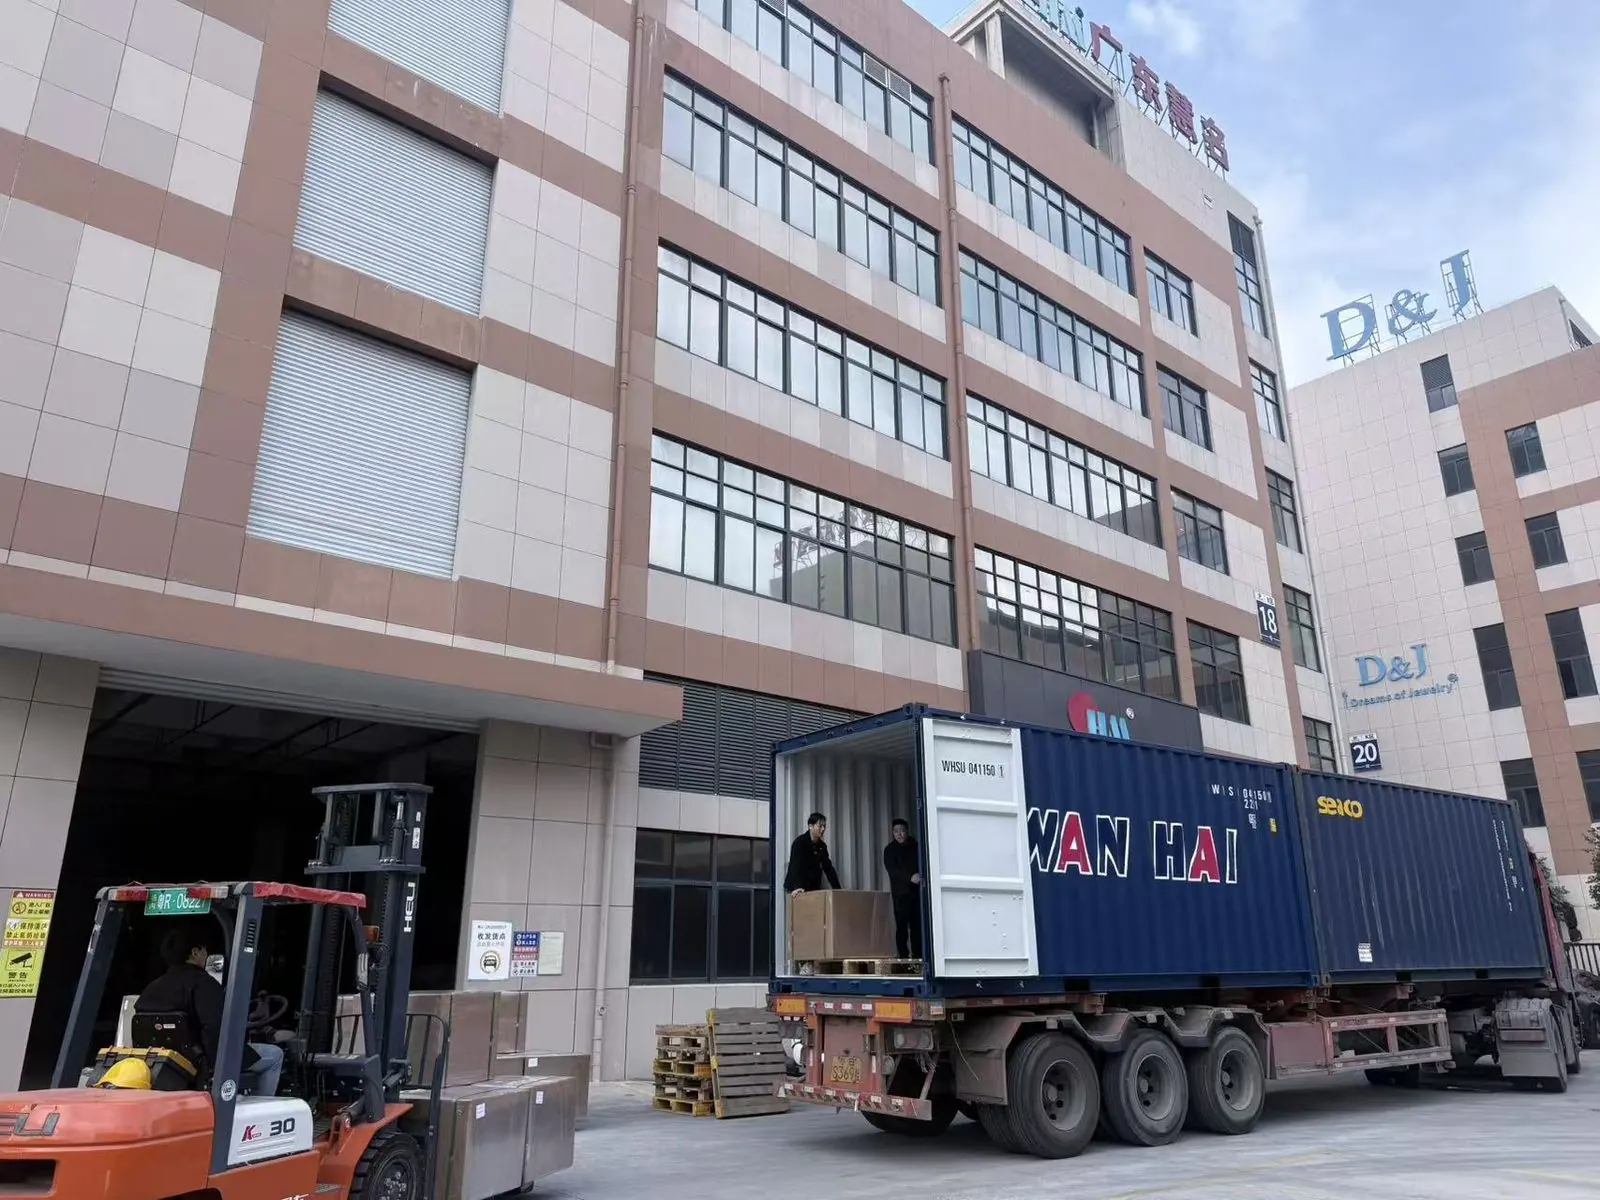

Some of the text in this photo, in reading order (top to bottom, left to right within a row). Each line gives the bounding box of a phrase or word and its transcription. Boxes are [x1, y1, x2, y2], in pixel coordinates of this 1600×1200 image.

[1320, 249, 1470, 361] D&J
[1259, 606, 1277, 634] 18
[1355, 643, 1427, 687] D&J
[1353, 742, 1377, 763] 20
[941, 760, 966, 774] WHSU
[968, 762, 996, 777] 041150
[1027, 807, 1238, 884] WAN HAI
[269, 1117, 296, 1137] 30
